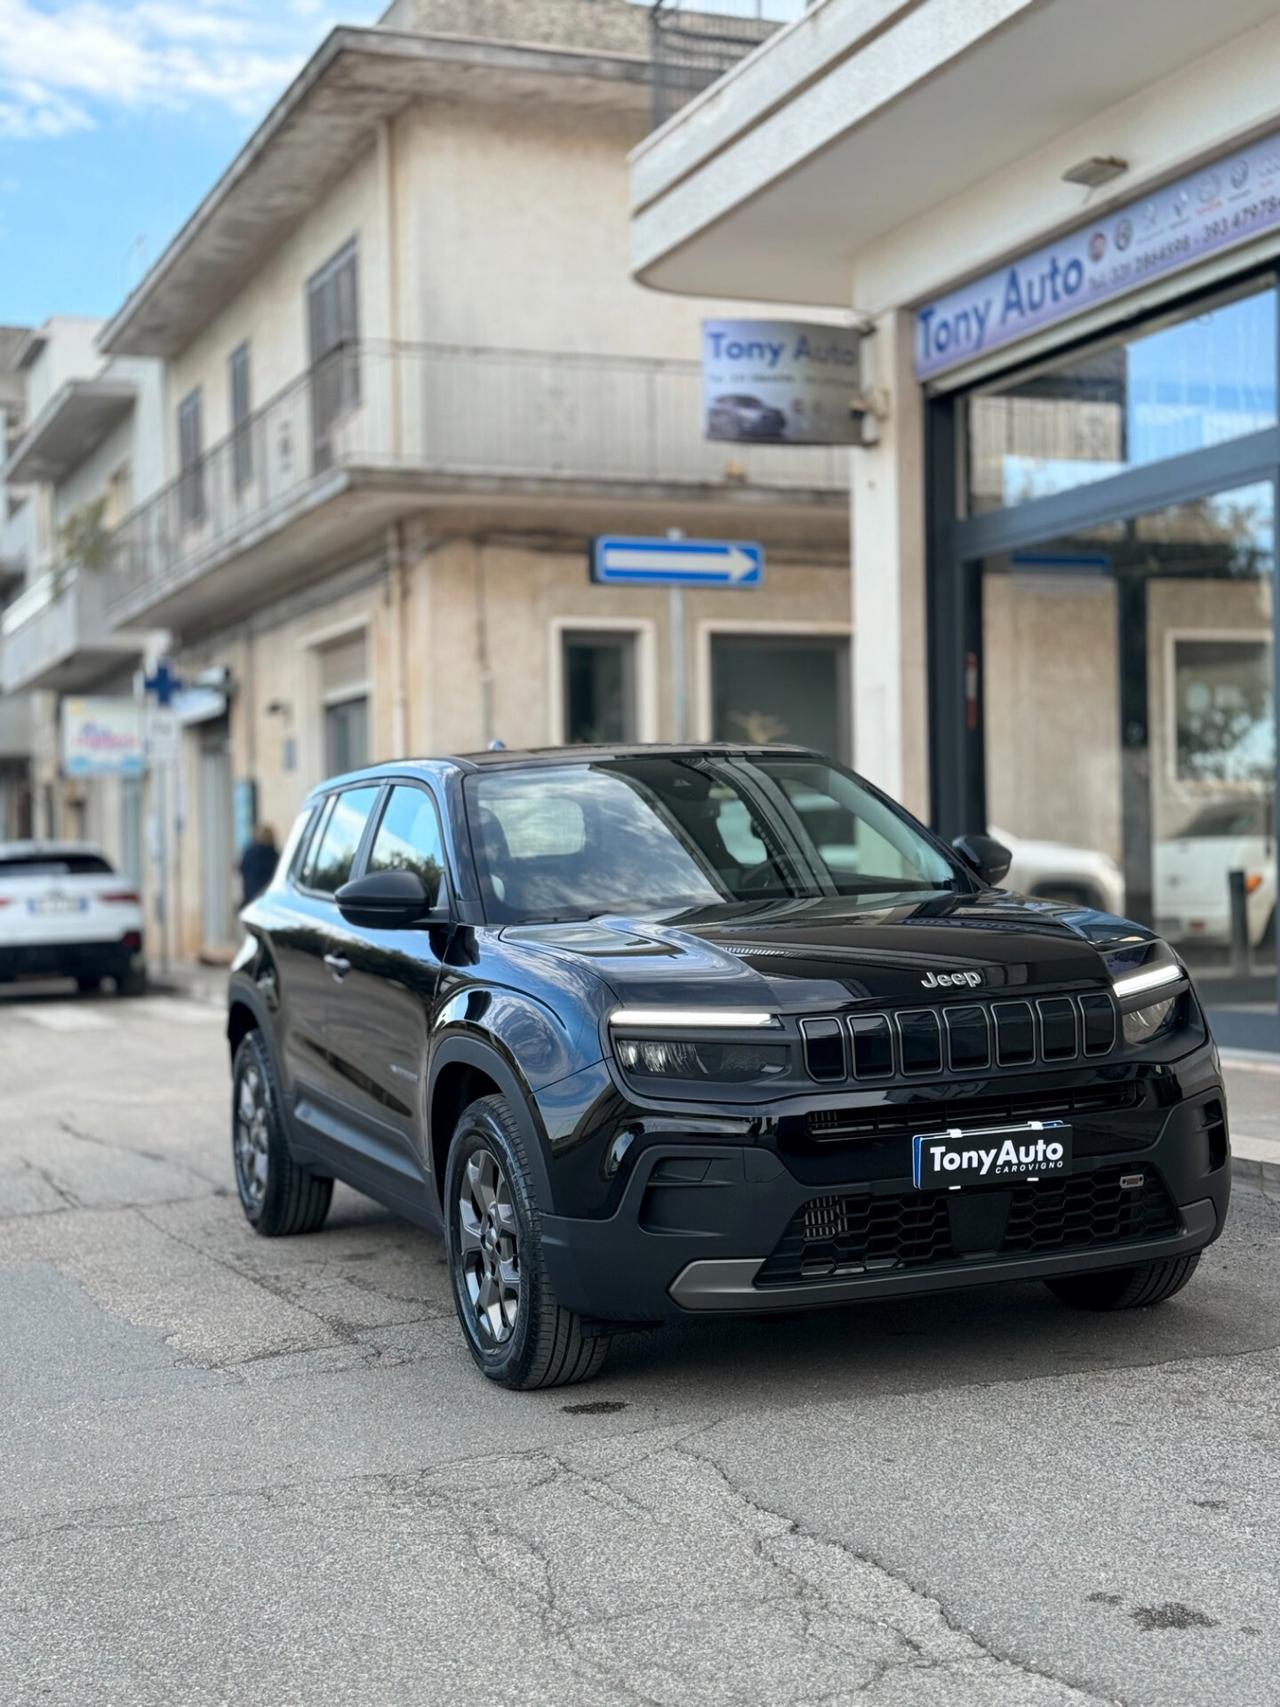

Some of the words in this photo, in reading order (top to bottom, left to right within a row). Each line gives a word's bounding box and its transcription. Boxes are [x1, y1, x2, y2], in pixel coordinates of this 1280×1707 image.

[918, 301, 992, 359] Tony
[1001, 257, 1084, 325] Auto
[707, 332, 785, 368] Tony
[793, 334, 857, 366] Auto
[921, 971, 982, 988] Jeep
[930, 1139, 1064, 1175] TonyAuto
[995, 1160, 1064, 1174] CAROVIGNO
